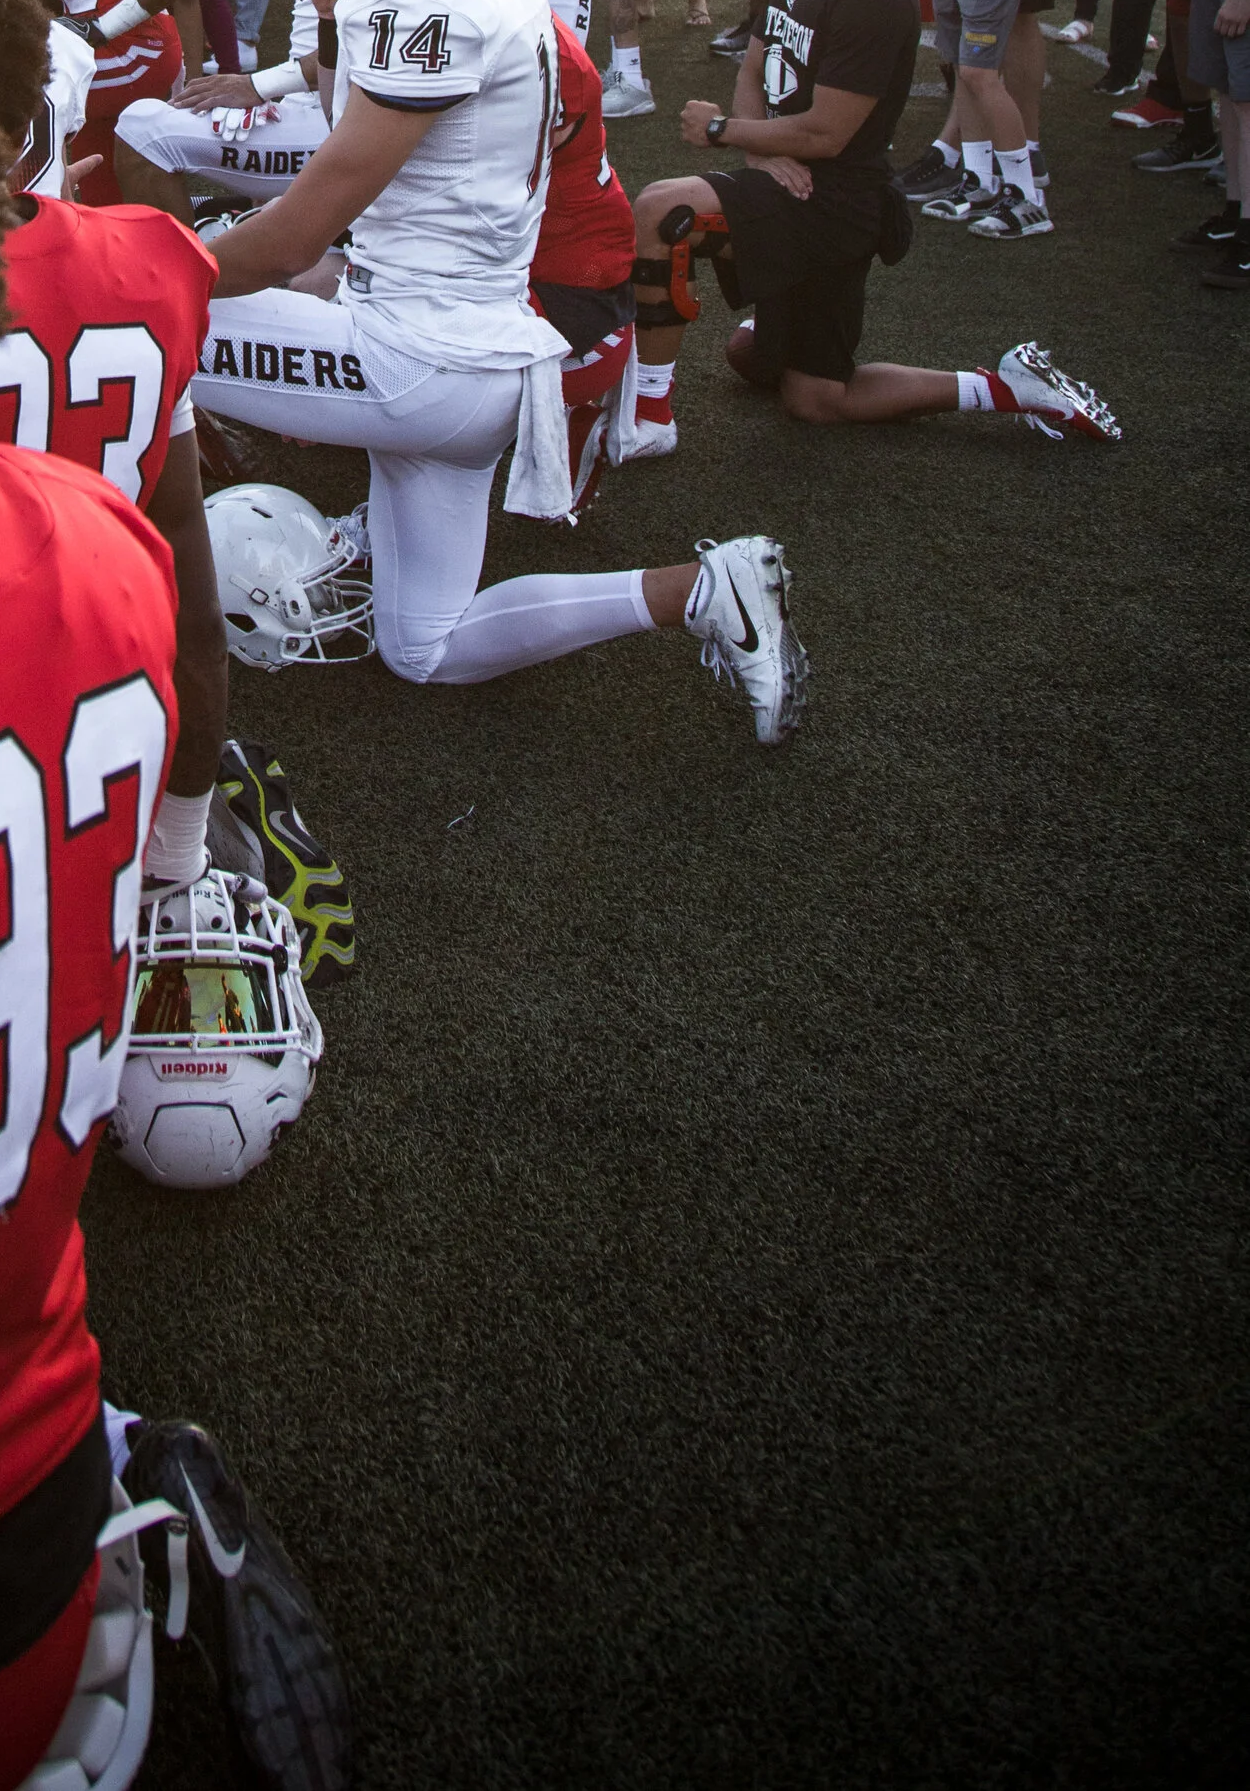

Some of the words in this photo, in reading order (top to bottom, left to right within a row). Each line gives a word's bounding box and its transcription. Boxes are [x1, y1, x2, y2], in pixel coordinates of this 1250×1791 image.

[368, 8, 451, 74] 14
[220, 146, 317, 175] RAIDE
[356, 271, 363, 281] L
[161, 1062, 228, 1075] Riddell
